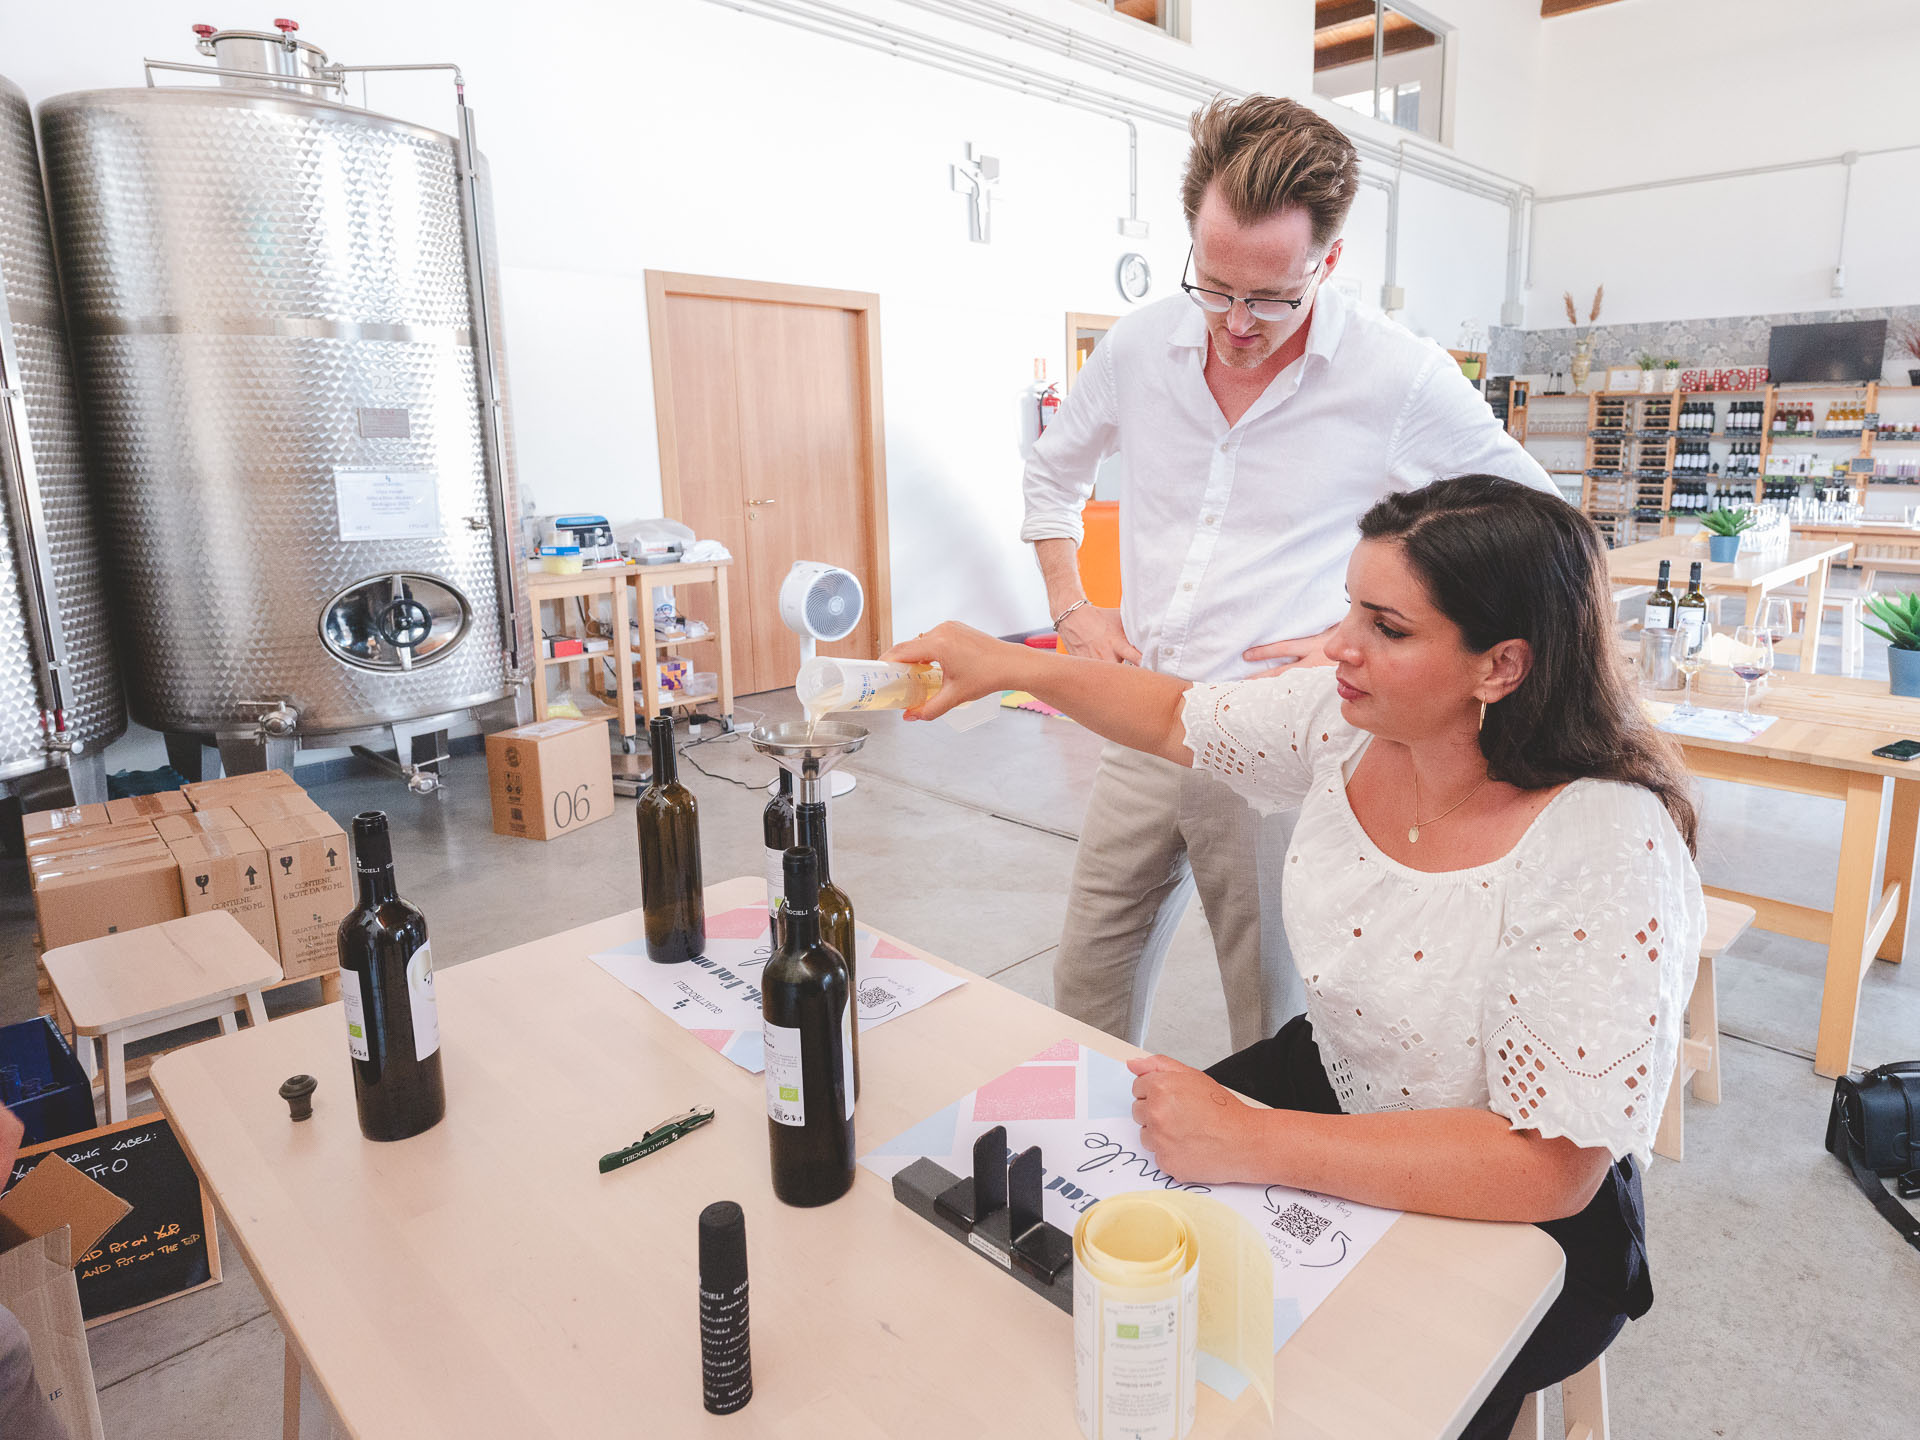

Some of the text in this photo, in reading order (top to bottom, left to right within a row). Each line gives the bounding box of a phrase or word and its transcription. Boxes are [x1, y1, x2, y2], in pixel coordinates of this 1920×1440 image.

[374, 375, 393, 389] 22
[1680, 367, 1769, 393] SHOP
[553, 784, 590, 829] 06
[295, 877, 333, 890] CONTIENE
[310, 886, 321, 896] DA
[334, 880, 345, 890] ML
[211, 897, 253, 911] CONTIENE
[254, 901, 266, 911] ML
[673, 980, 723, 1015] QUATTROCIELI
[65, 1148, 101, 1164] AZING
[621, 1138, 669, 1164] QUATTROCIELI
[81, 1249, 104, 1263] ND
[82, 1264, 112, 1280] AND
[158, 1243, 179, 1255] THE
